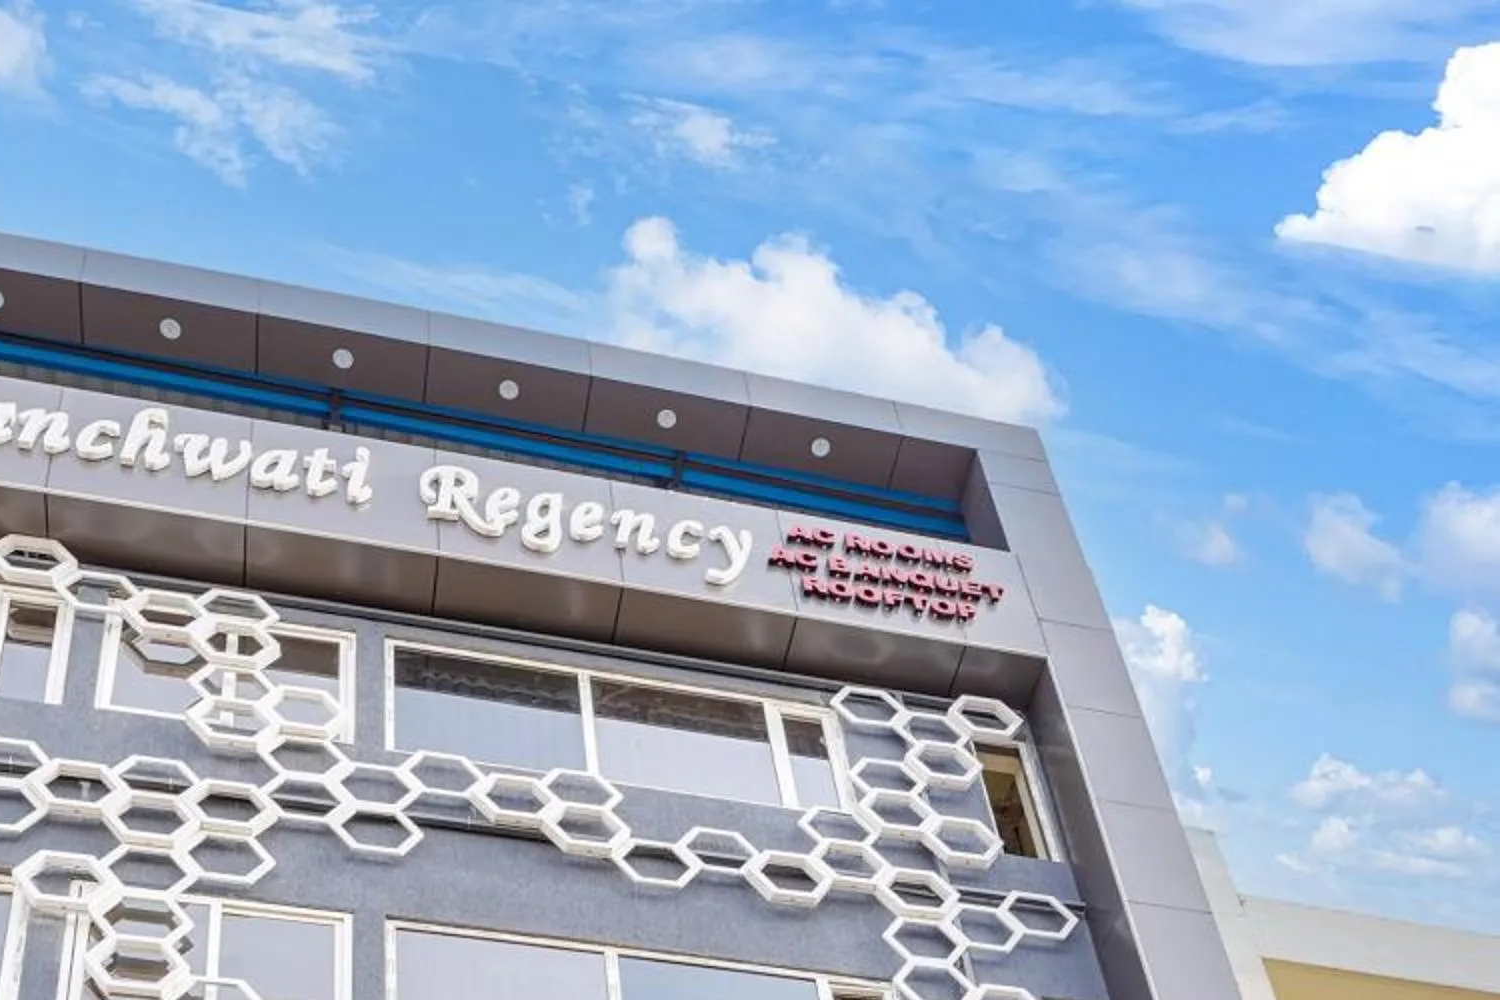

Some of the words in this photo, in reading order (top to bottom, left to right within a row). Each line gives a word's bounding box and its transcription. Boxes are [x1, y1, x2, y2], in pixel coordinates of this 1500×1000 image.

[419, 464, 752, 587] Regency
[786, 523, 837, 550] AC
[843, 532, 976, 574] ROOMS
[767, 544, 820, 573] AC
[827, 553, 1008, 605] BANQUET
[801, 575, 979, 623] ROOFTOP
